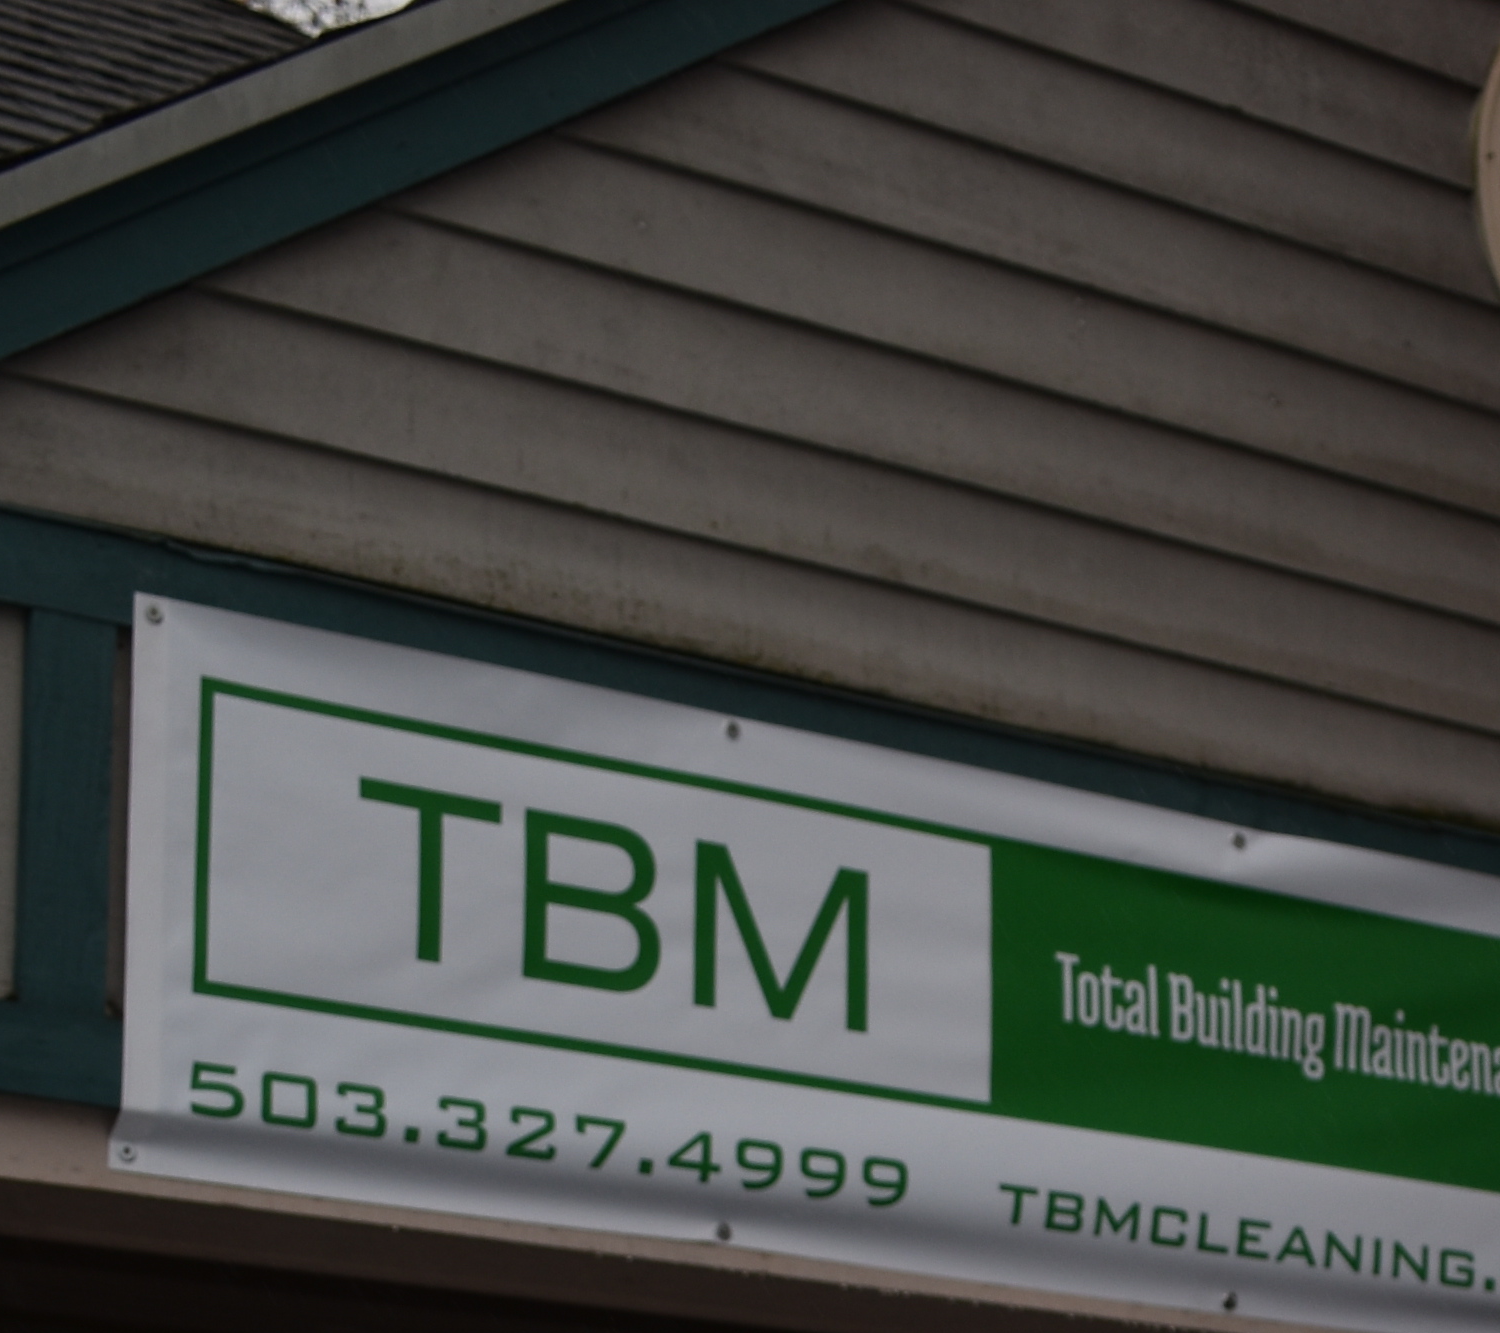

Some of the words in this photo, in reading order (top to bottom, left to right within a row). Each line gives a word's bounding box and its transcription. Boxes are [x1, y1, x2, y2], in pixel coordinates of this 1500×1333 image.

[359, 776, 869, 1033] TBM
[1054, 950, 1161, 1038] Total
[1167, 971, 1326, 1081] Building
[189, 1061, 910, 1208] 503.327.4999
